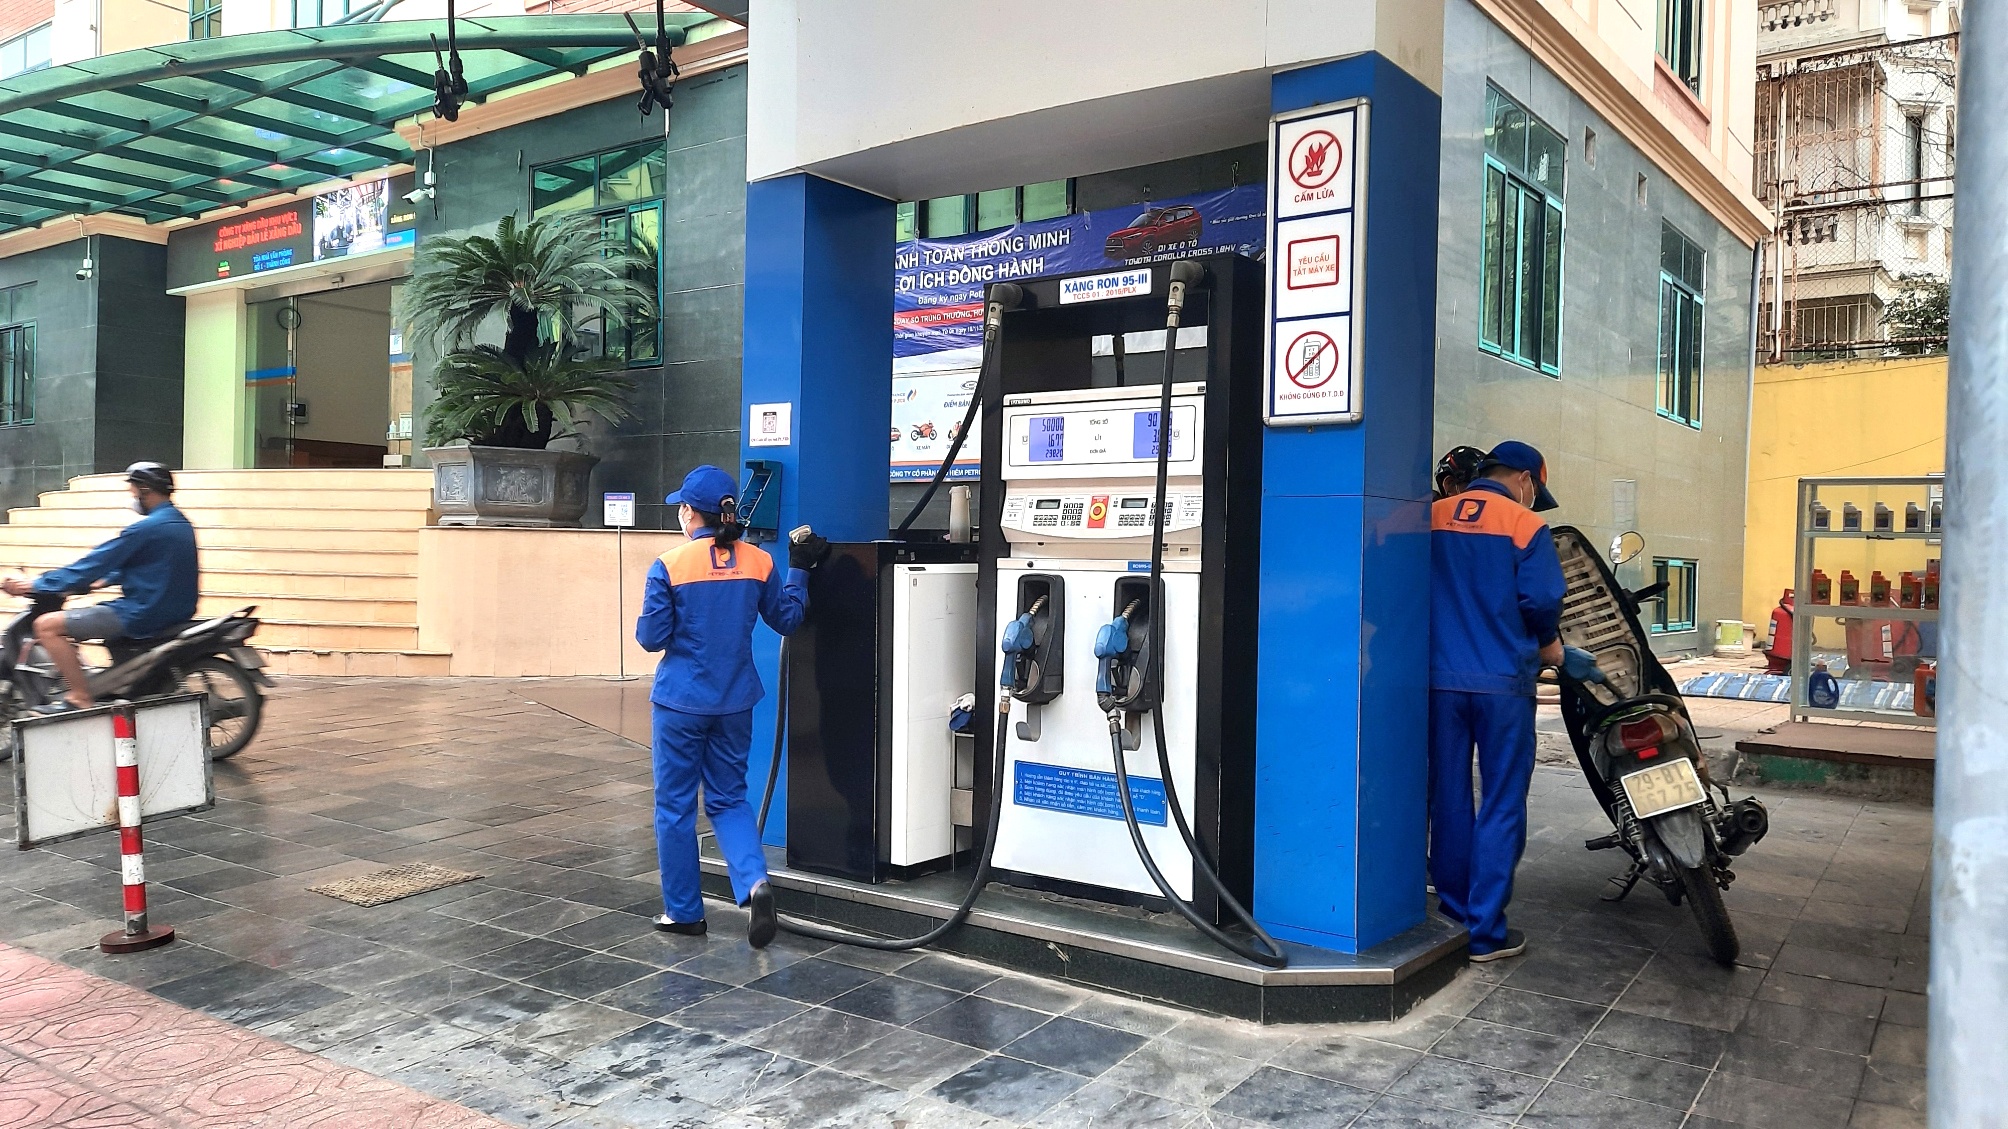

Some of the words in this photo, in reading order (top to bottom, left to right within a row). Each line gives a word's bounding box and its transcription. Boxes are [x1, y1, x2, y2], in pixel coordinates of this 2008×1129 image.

[1294, 190, 1314, 203] CẤM
[1316, 188, 1334, 199] LỬA
[1030, 229, 1070, 250] MINH
[1124, 256, 1152, 266] TOYOTA
[1154, 251, 1186, 262] COROLLA
[1188, 248, 1214, 257] CROSS
[1298, 256, 1312, 266] YÊU
[920, 271, 944, 289] ÍCH
[998, 257, 1044, 279] HÀNH
[1308, 264, 1324, 274] MÁY
[1097, 277, 1120, 290] RON
[1122, 273, 1148, 286] 95-III
[918, 295, 937, 305] Đăng
[939, 294, 949, 304] ký
[950, 292, 966, 302] ngay
[1073, 292, 1090, 300] TCCS
[921, 313, 941, 322] TRÚNG
[1280, 392, 1301, 400] KHÔNG
[1042, 417, 1064, 432] 50000
[1632, 764, 1683, 792] 29-B1
